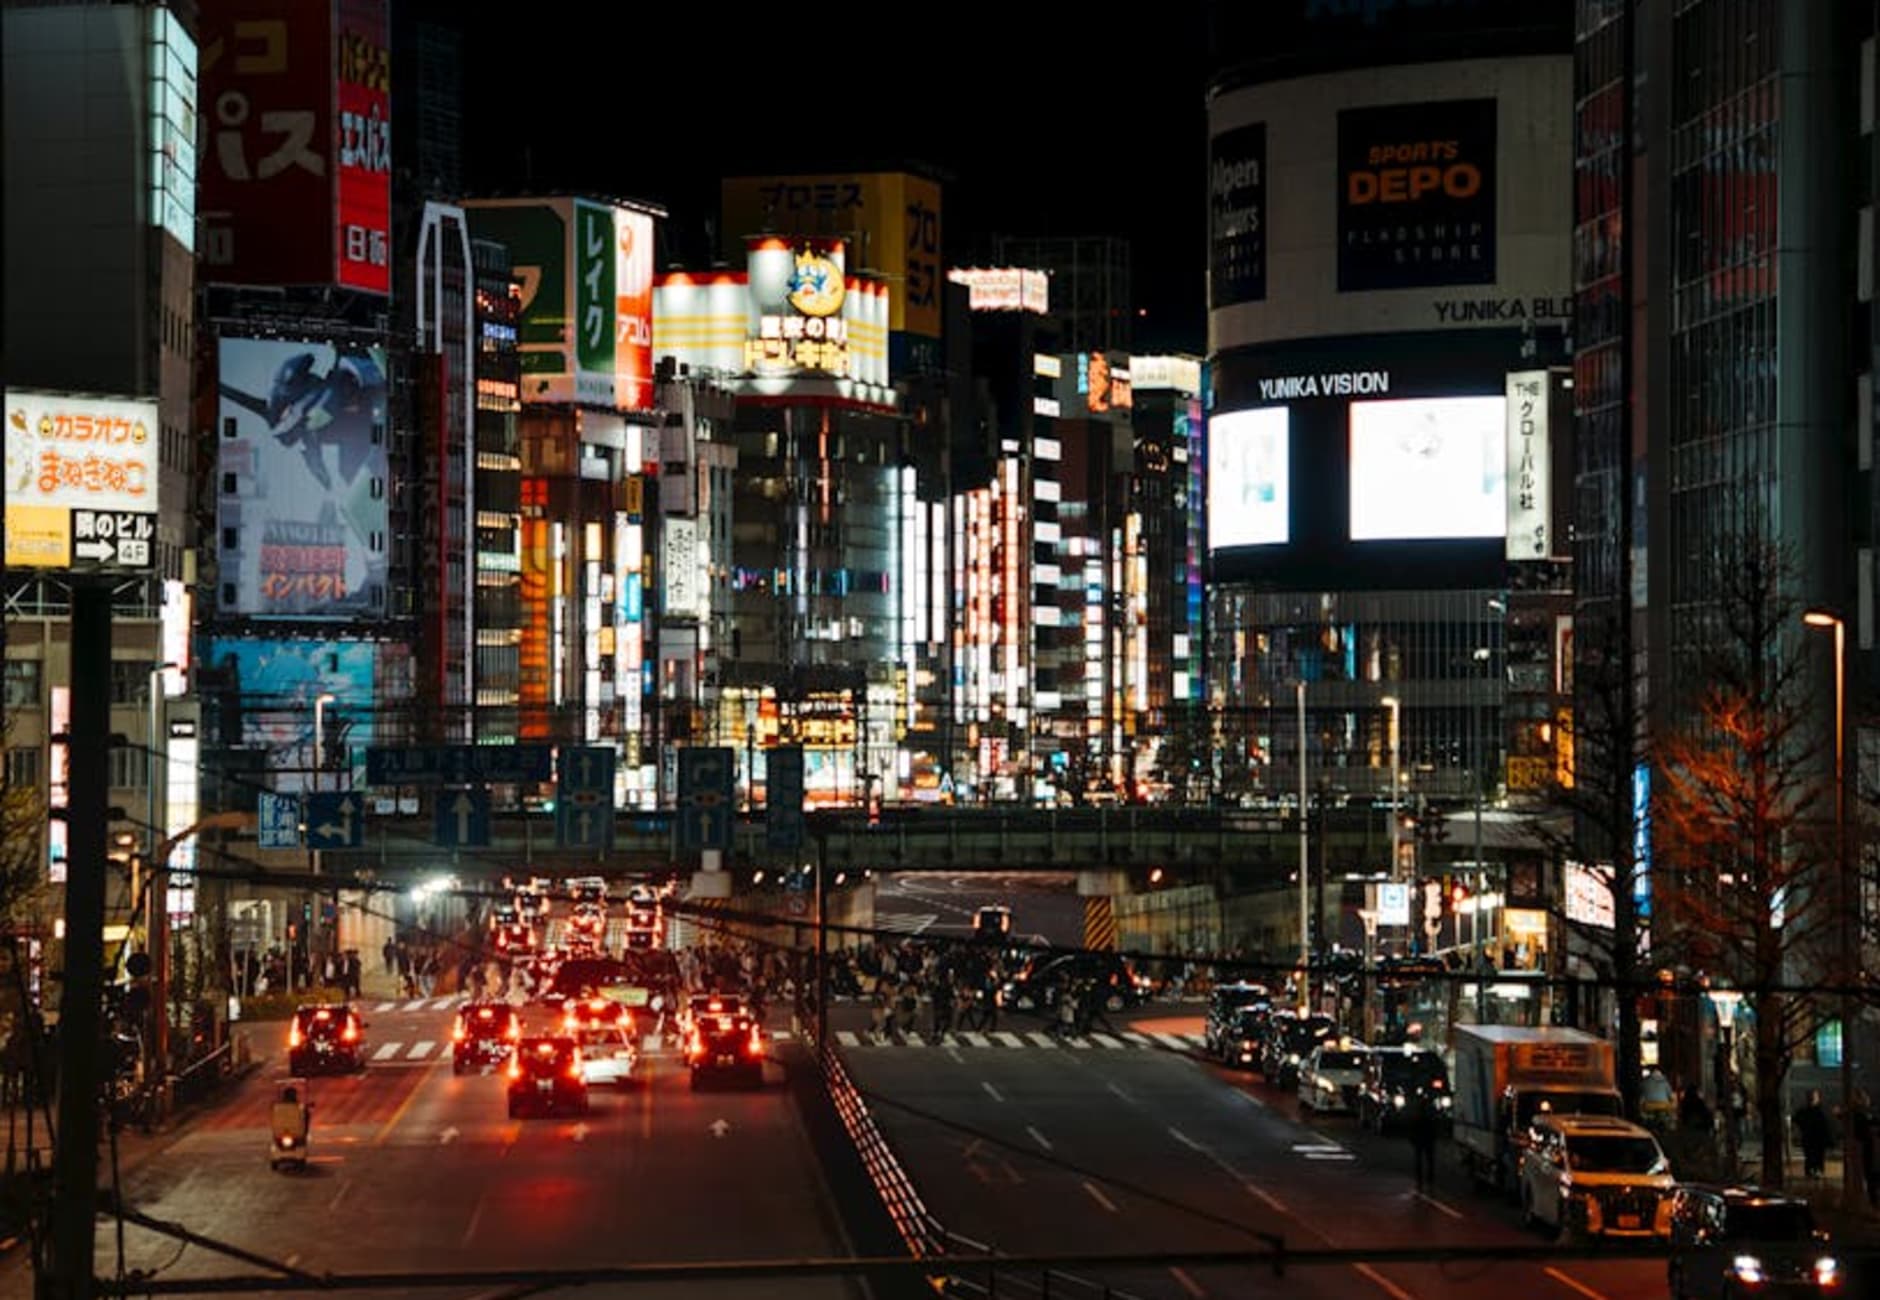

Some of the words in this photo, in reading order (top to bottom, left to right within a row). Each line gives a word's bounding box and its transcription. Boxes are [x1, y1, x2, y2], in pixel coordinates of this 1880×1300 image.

[1368, 140, 1459, 165] SPORTS
[759, 183, 863, 210] プロミス
[1348, 163, 1482, 204] DEPO
[1348, 222, 1483, 244] FLAGSHIP
[1395, 244, 1482, 264] STORE
[585, 214, 604, 350] レイク
[1434, 299, 1527, 323] YUNIKA
[618, 317, 651, 348] アコム
[1259, 376, 1317, 399] YUNIKA
[1321, 372, 1390, 396] VISION
[55, 415, 132, 444] カラオケ
[38, 452, 146, 497] まねきねこ
